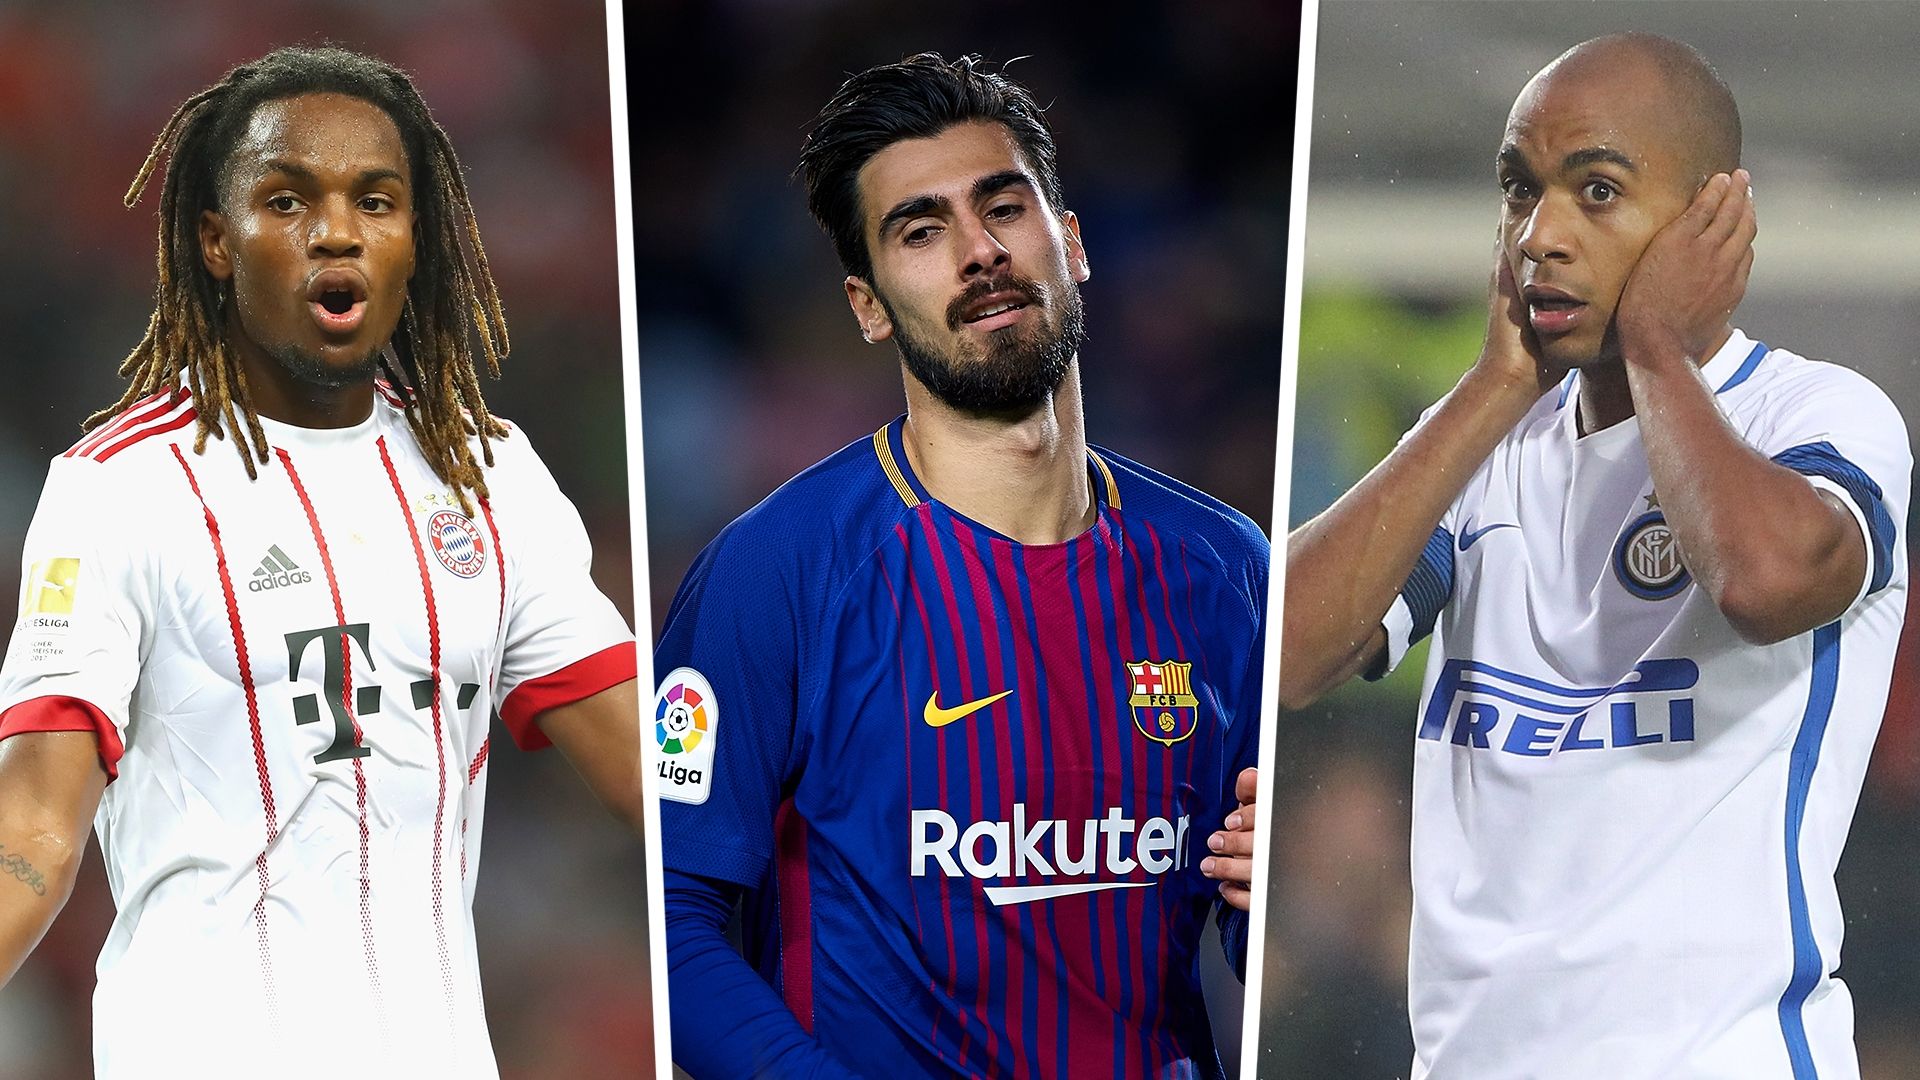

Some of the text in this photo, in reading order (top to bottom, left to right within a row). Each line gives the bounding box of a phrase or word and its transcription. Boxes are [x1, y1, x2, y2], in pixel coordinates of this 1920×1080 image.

[431, 514, 480, 541] FC BAYERN
[248, 571, 312, 592] adidas
[1150, 695, 1177, 706] FCB
[657, 760, 702, 785] Liga
[911, 803, 1190, 879] Rakuten
